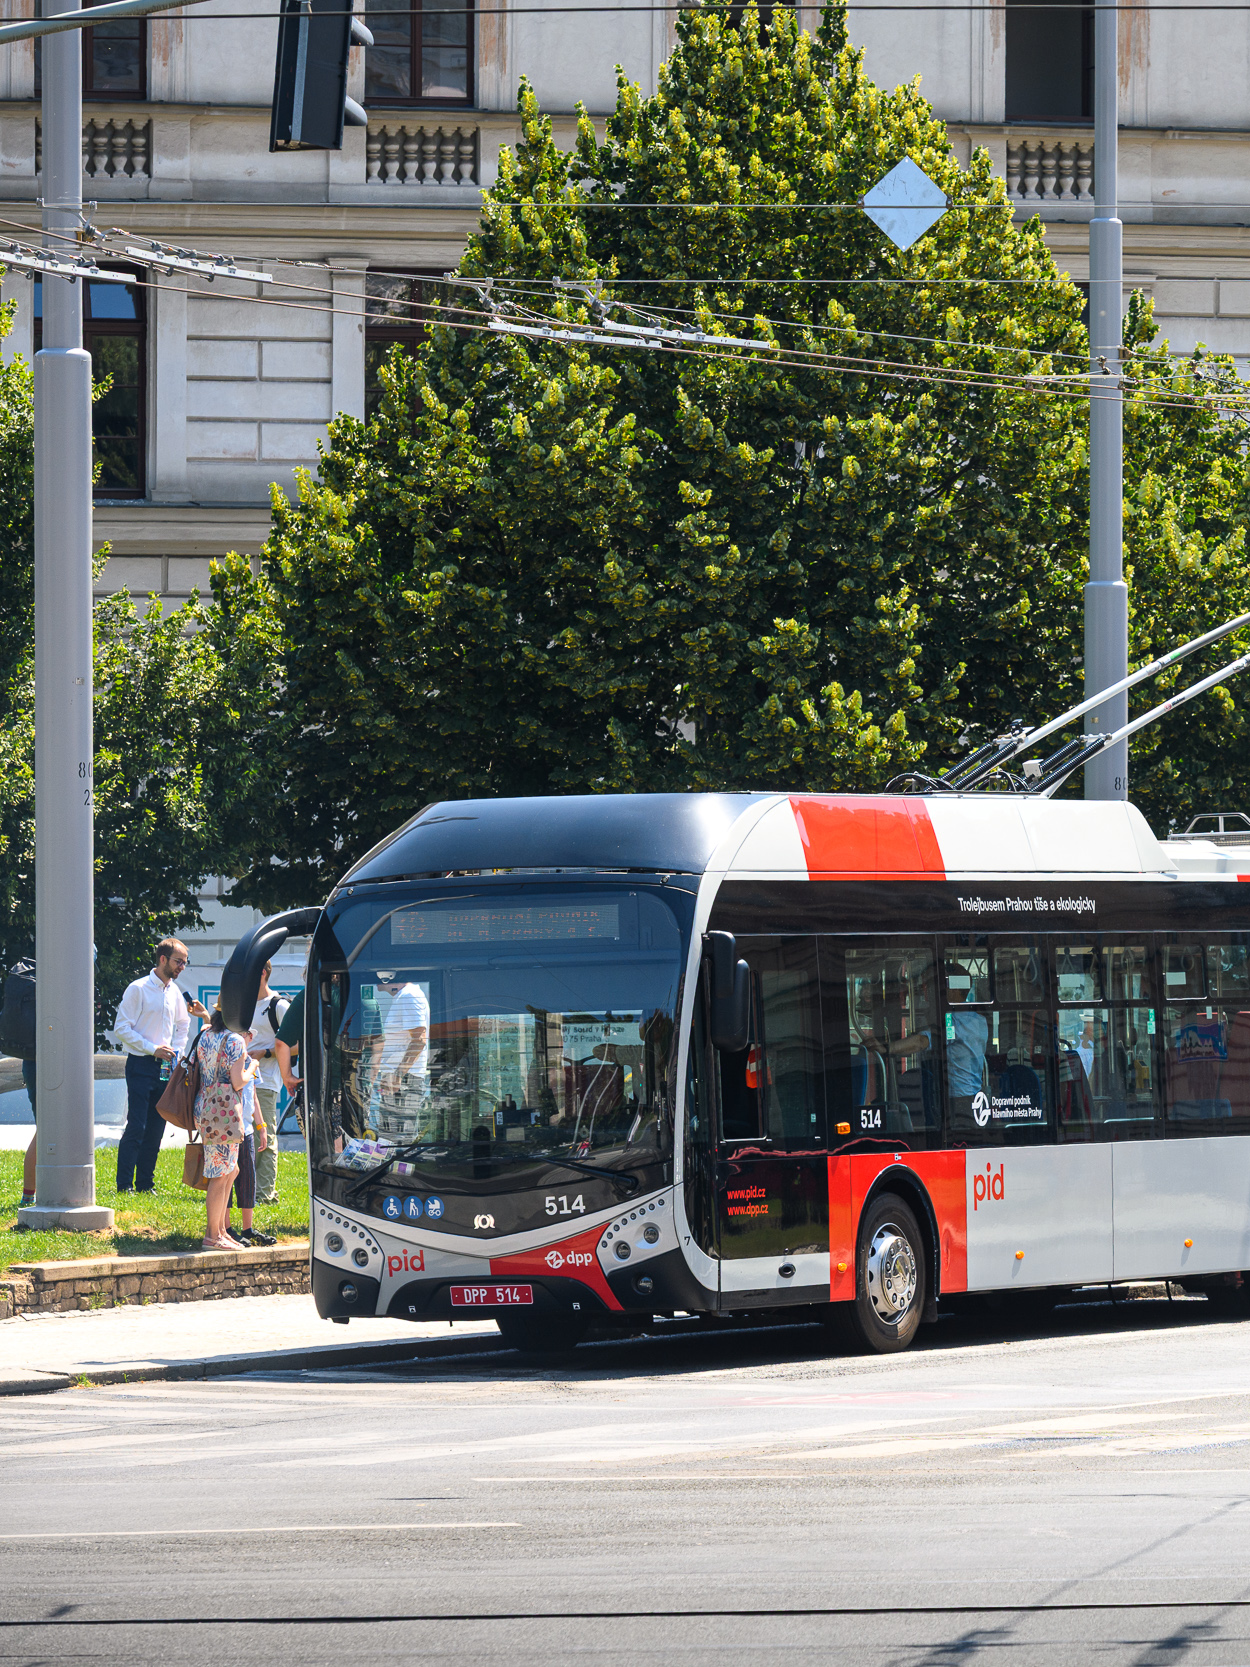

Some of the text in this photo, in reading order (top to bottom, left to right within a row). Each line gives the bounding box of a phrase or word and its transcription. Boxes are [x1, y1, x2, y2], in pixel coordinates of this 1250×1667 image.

[957, 896, 1096, 915] Trolejbusem Prahou tiše a ekologicky
[991, 1094, 1032, 1108] Dopravní podnik
[860, 1108, 882, 1129] 514
[992, 1107, 1042, 1119] hlavního města Prahy
[726, 1185, 766, 1201] www.pid.cz
[973, 1162, 1004, 1211] pid
[544, 1194, 586, 1216] 514
[727, 1202, 769, 1217] www.dpp.cz
[684, 1236, 691, 1246] 7
[387, 1248, 426, 1277] pid
[566, 1250, 593, 1267] dpp
[463, 1287, 521, 1303] DPP 514
